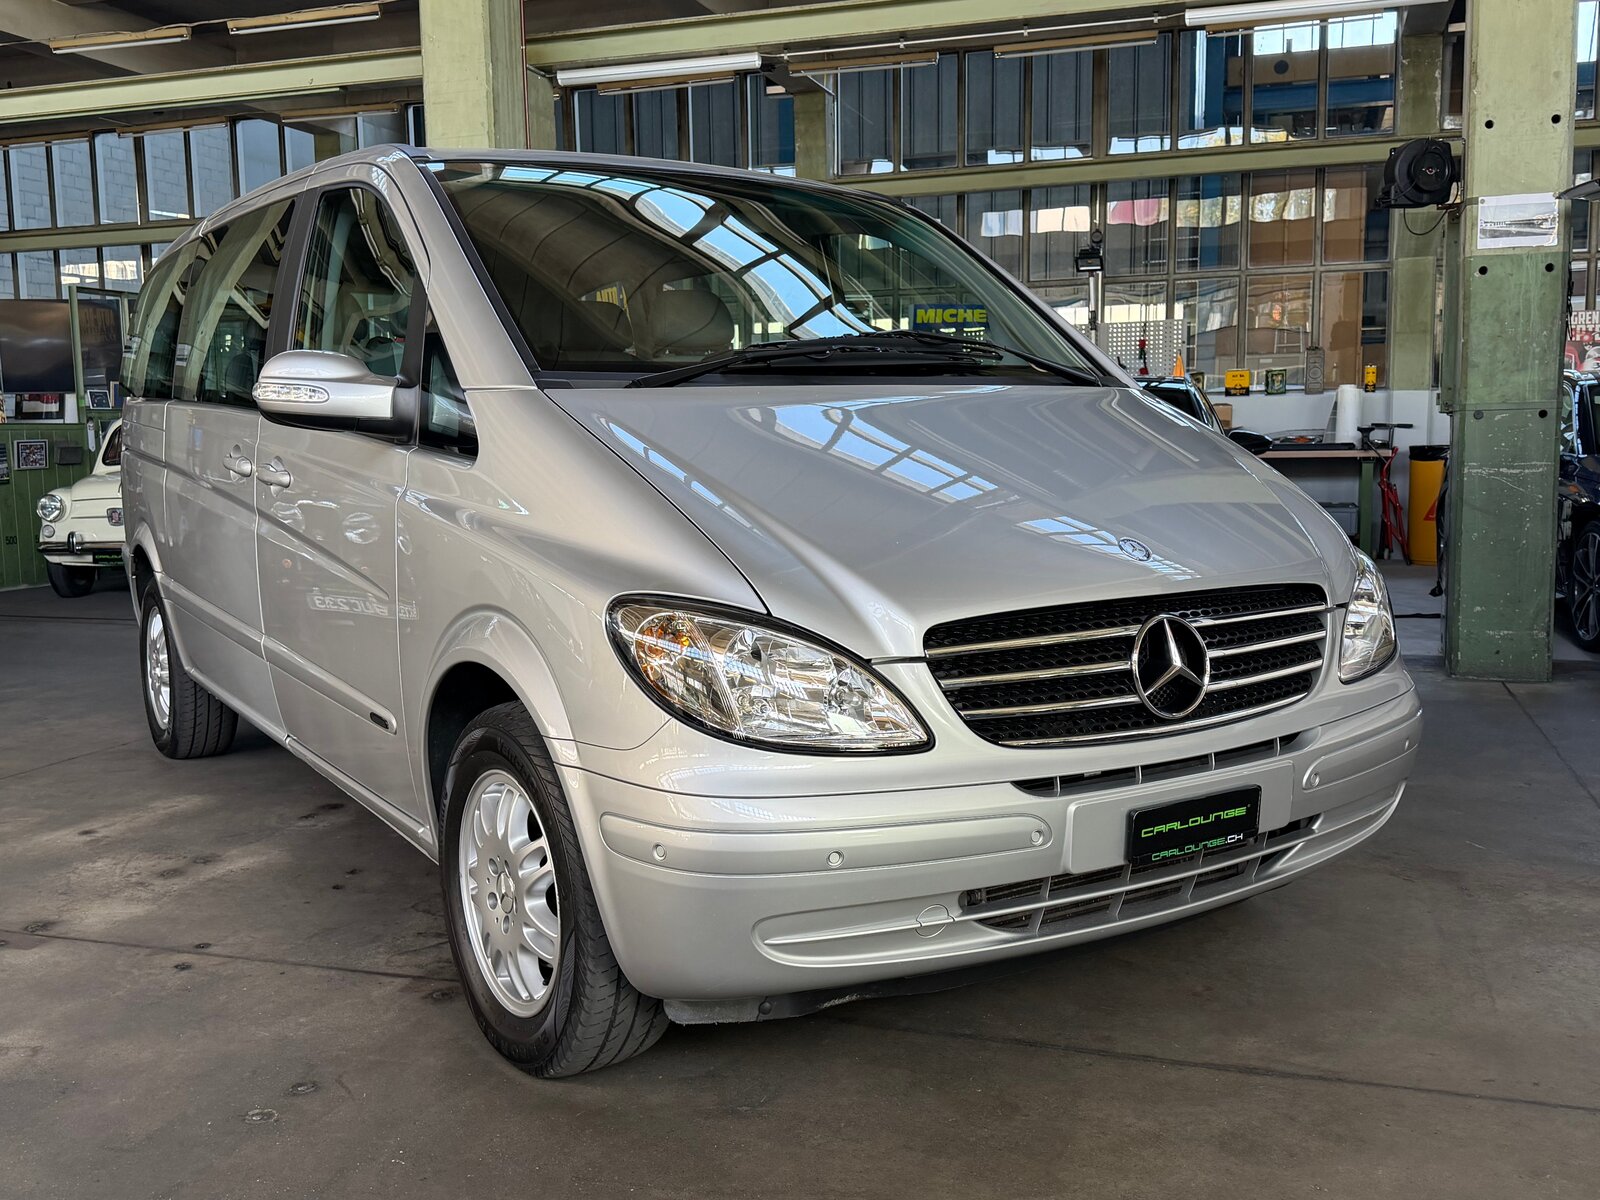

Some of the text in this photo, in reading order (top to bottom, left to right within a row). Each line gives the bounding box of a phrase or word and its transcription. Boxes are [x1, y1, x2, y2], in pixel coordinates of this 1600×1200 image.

[916, 308, 988, 324] MICHE
[1141, 806, 1248, 838] CARLOUNGE
[1151, 832, 1244, 861] CARLOUNGE.CH
